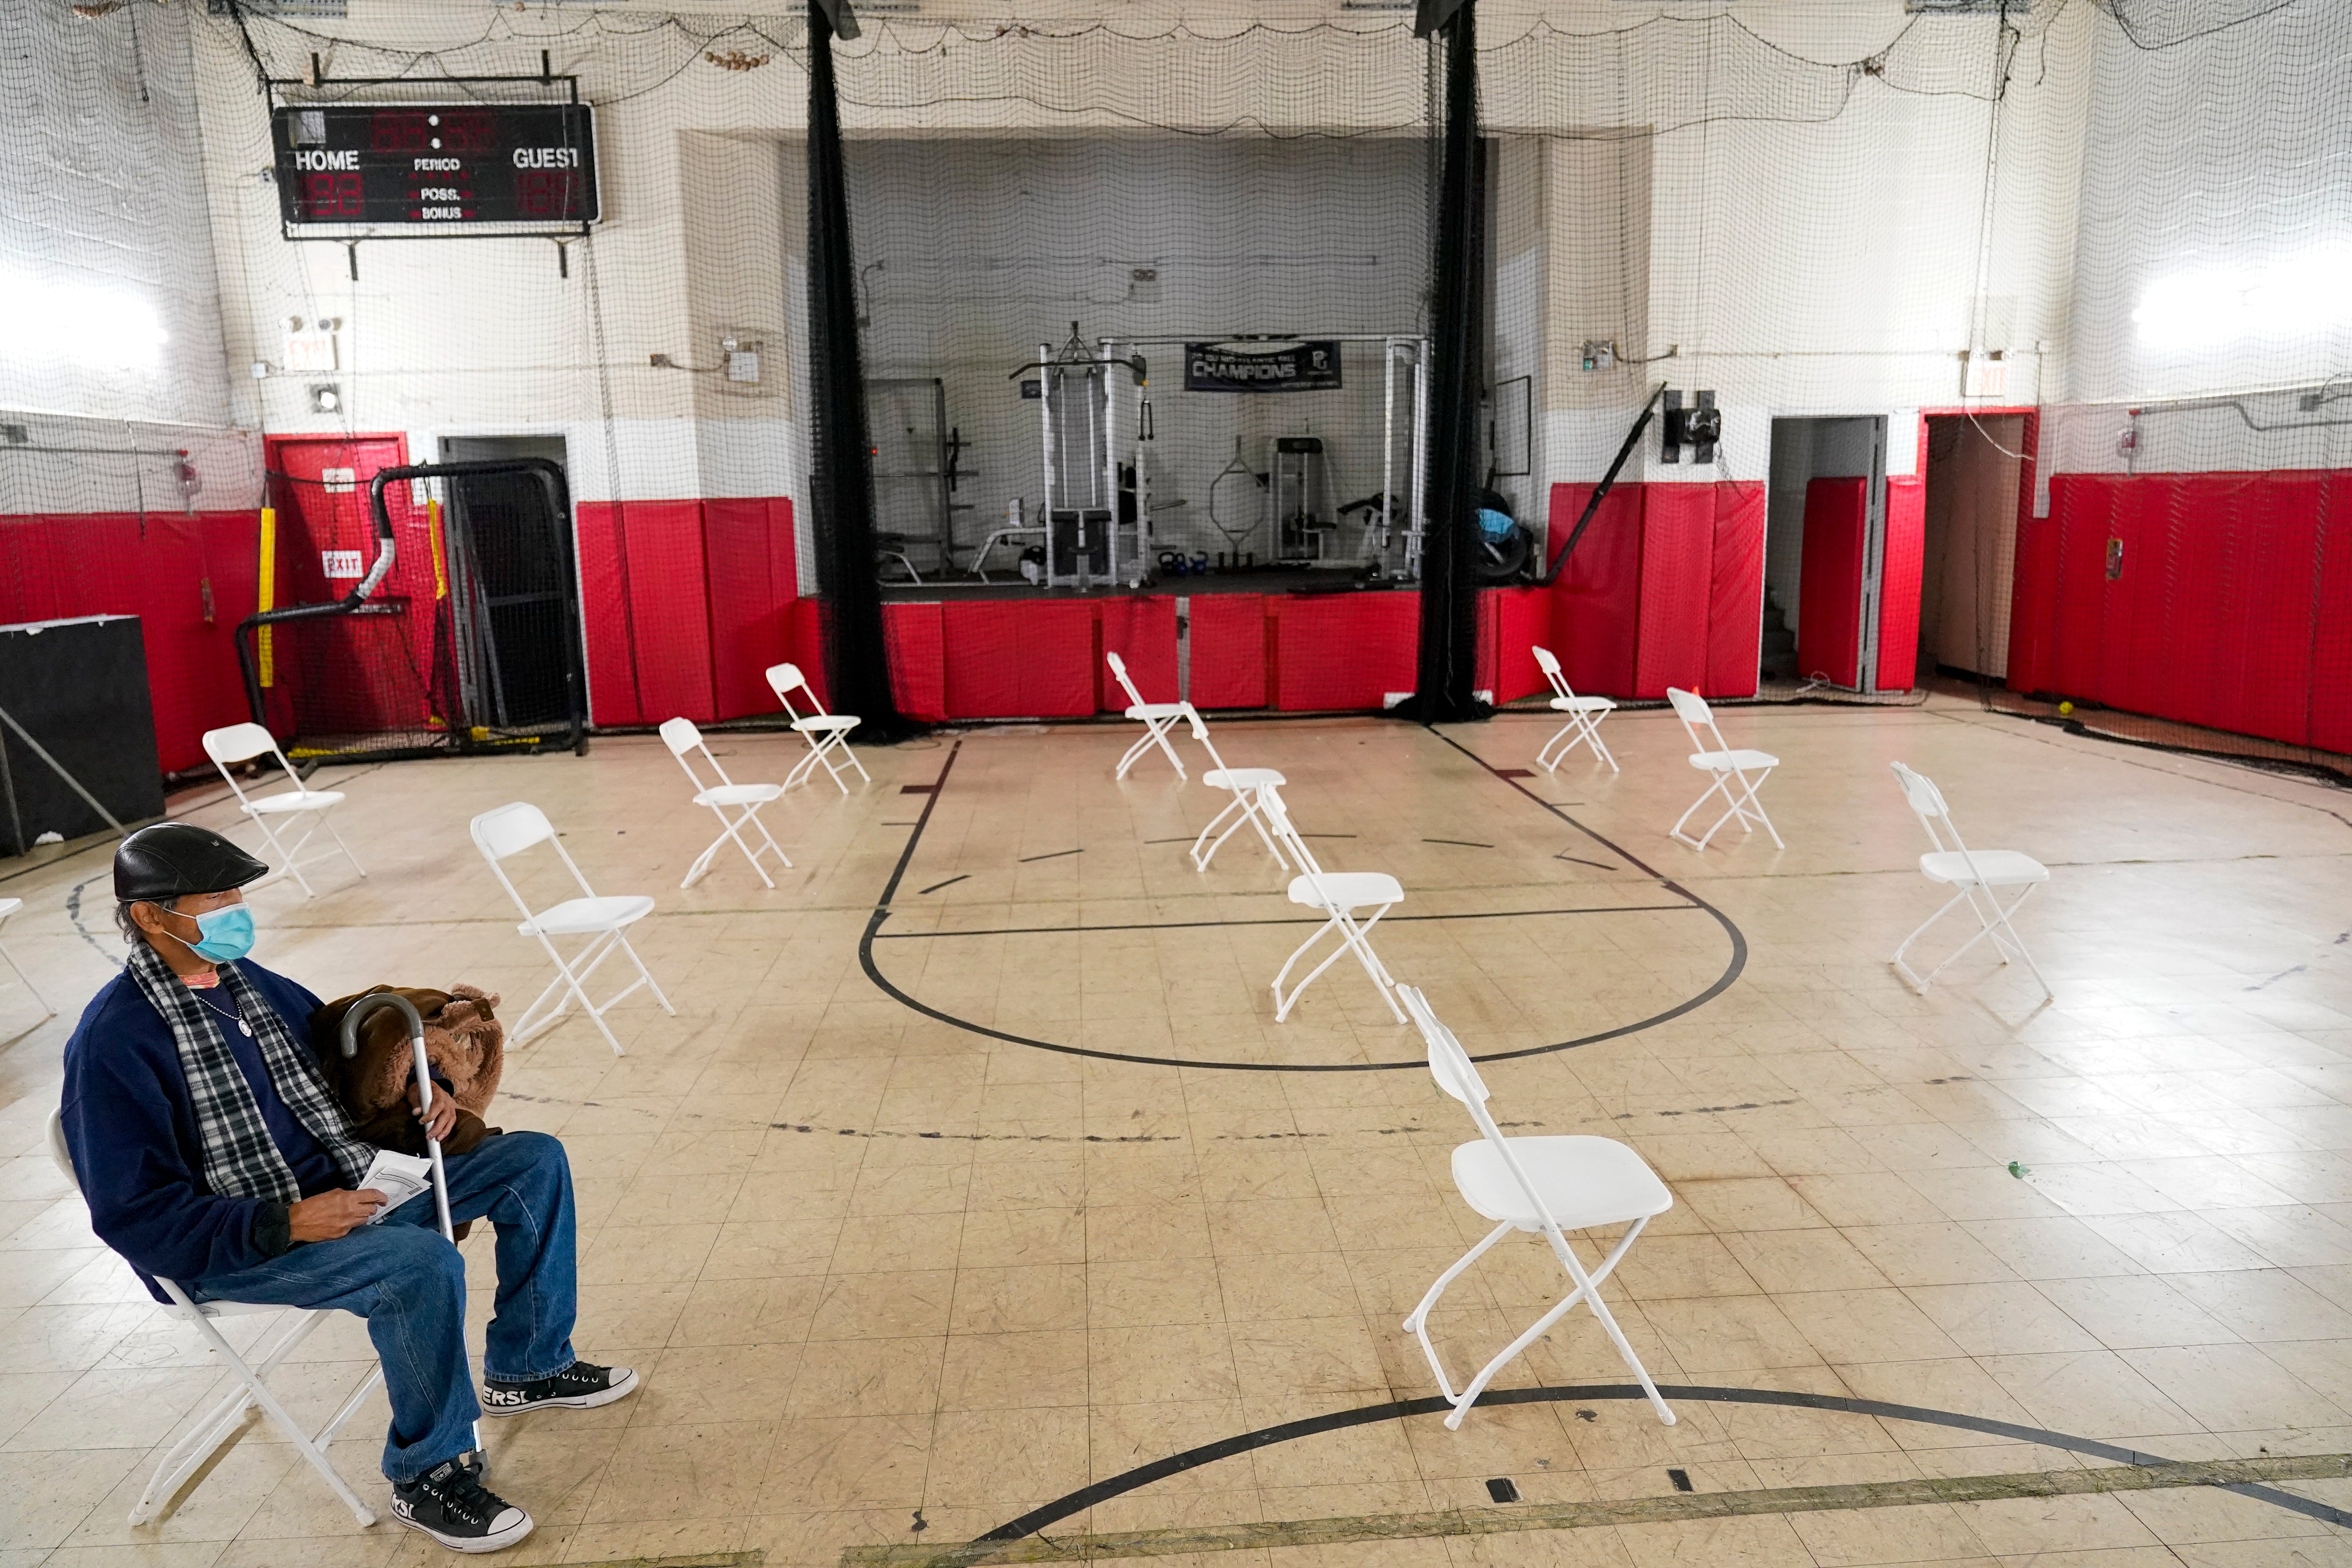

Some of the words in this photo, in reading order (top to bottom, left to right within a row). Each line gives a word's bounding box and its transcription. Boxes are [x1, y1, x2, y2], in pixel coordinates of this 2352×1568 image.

[296, 150, 361, 171] HOME
[414, 158, 461, 171] PERIOD
[513, 148, 579, 168] GUEST
[421, 187, 461, 201] POSS.
[422, 207, 462, 219] BONUS
[1192, 361, 1296, 380] CHAMPIONS
[327, 557, 358, 572] EXIT
